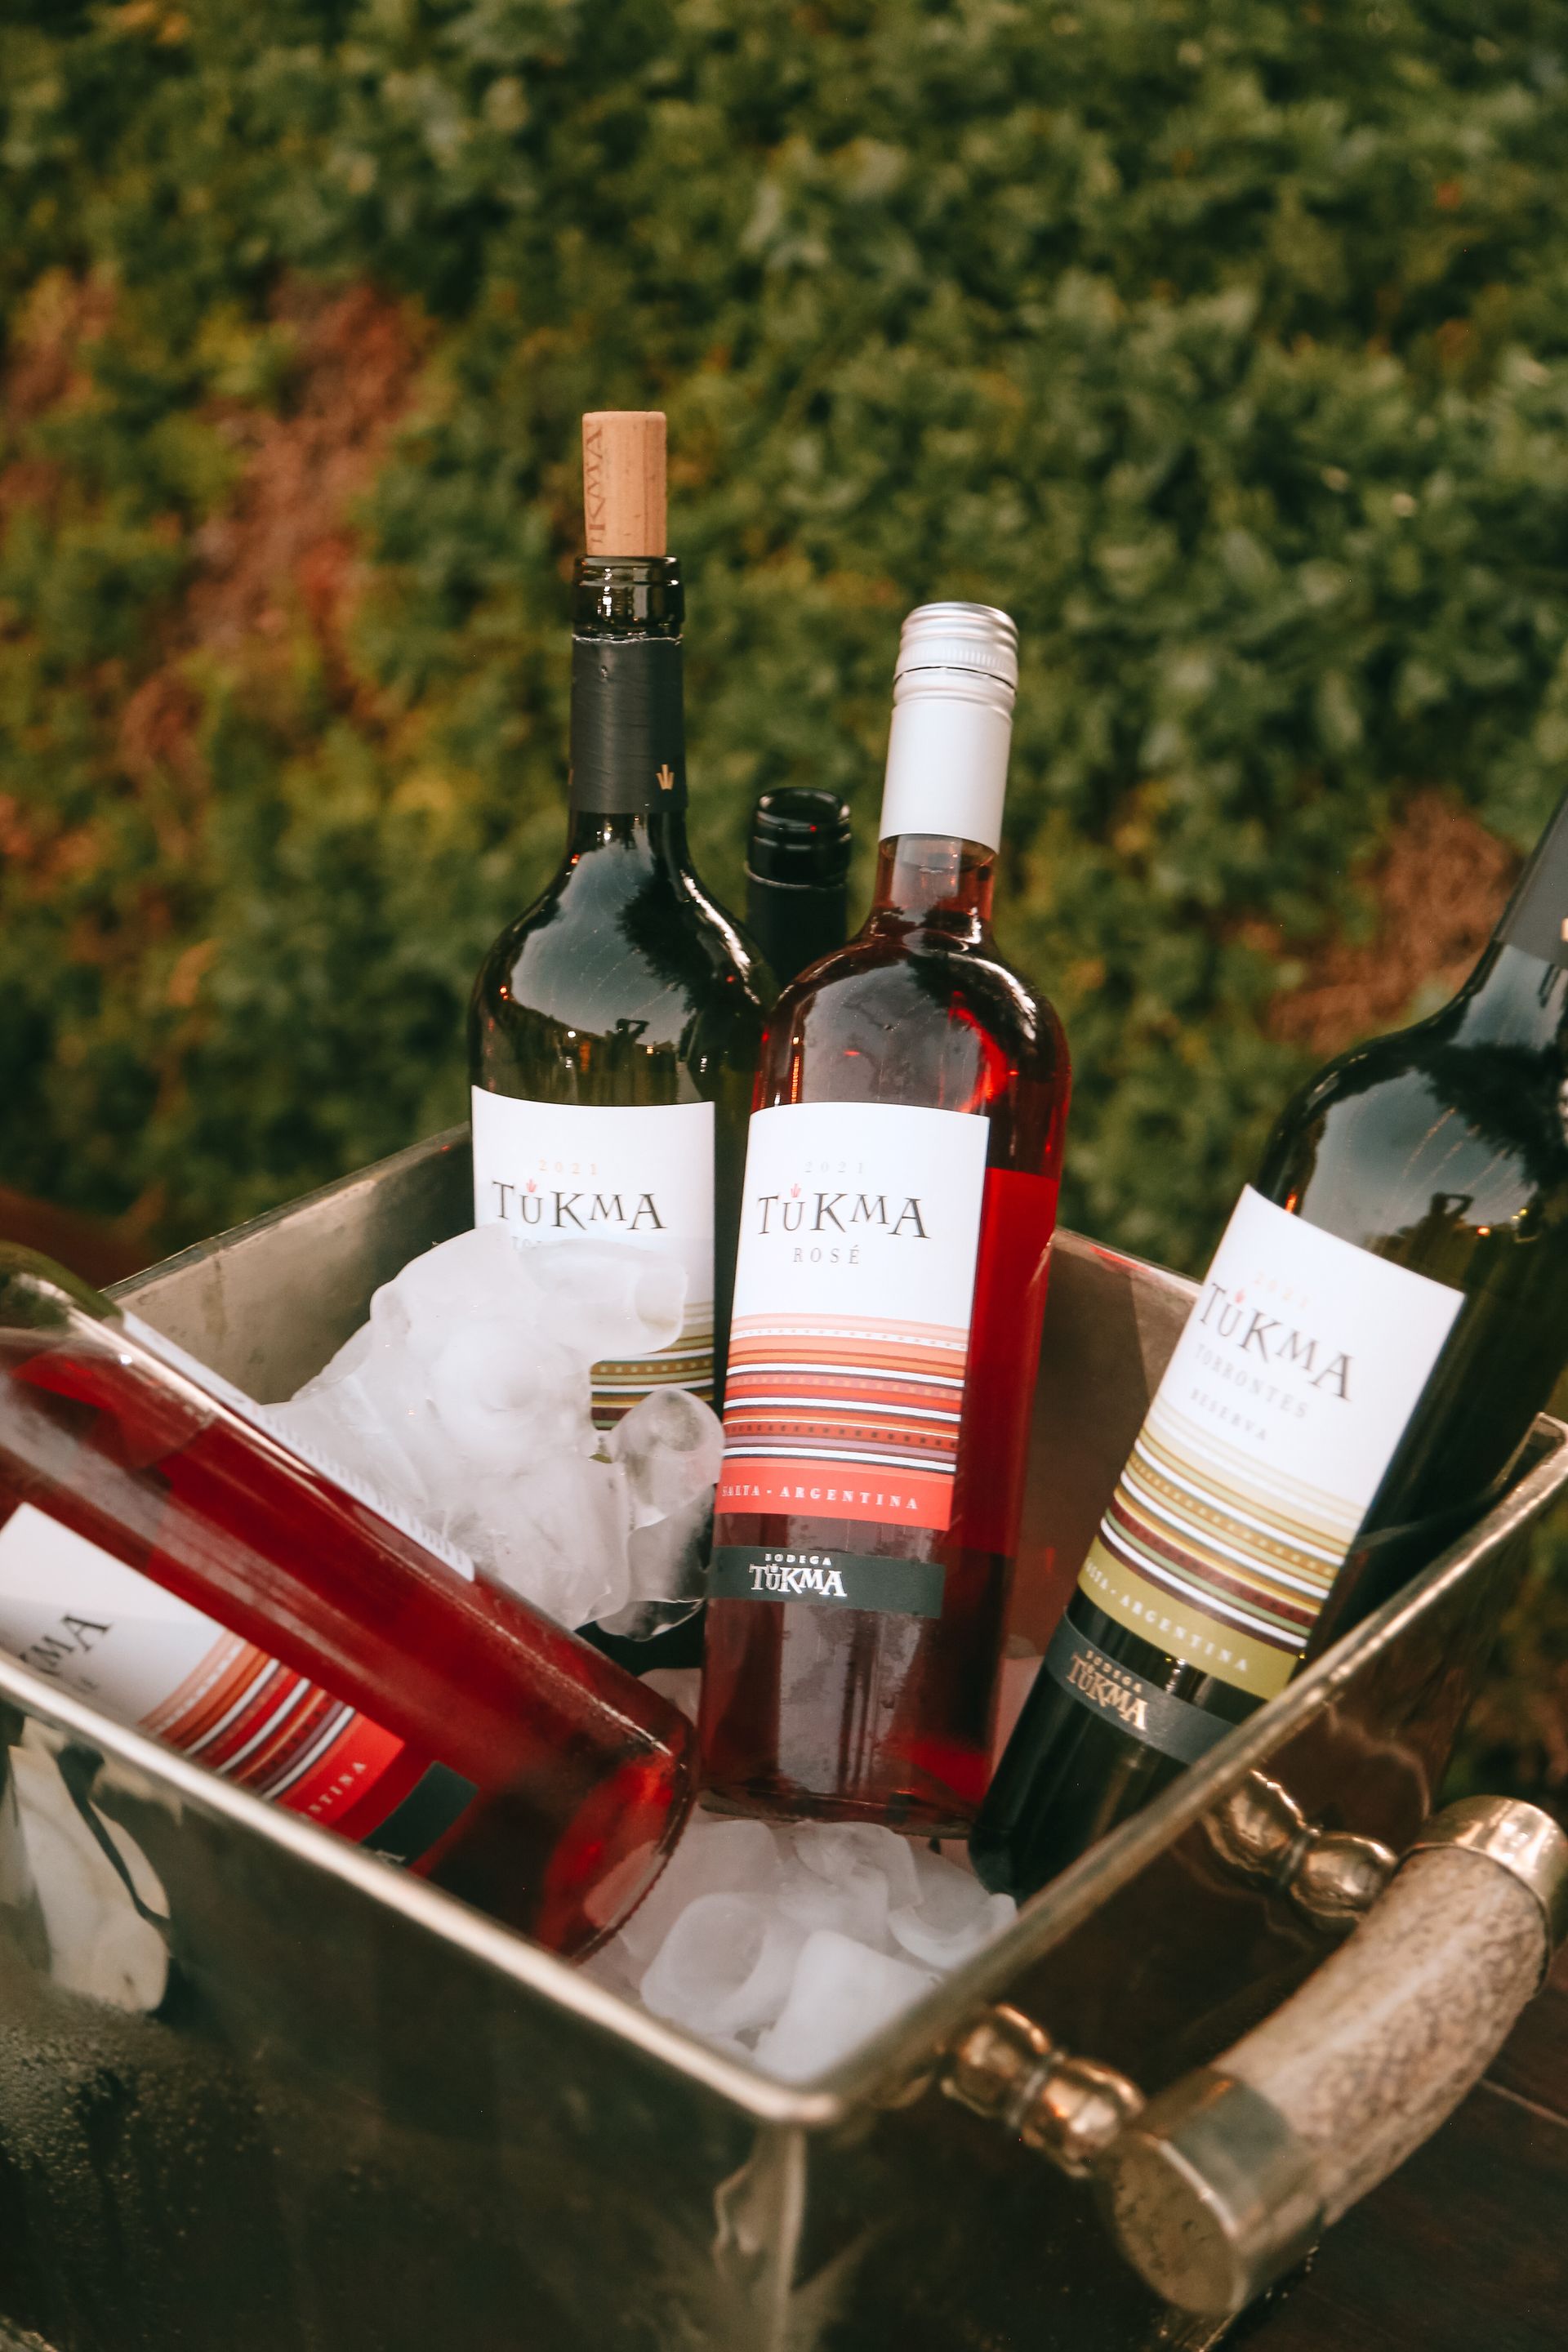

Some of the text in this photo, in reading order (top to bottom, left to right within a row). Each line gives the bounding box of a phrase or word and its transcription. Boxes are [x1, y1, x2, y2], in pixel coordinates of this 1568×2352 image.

[537, 1159, 599, 1175] 2021
[804, 1160, 864, 1174] 2021
[793, 1245, 860, 1265] ROSÉ
[722, 1485, 919, 1510] SALTA ARGENTINA
[764, 1553, 832, 1566] BODEGA
[1119, 1594, 1248, 1672] ARGENTINA
